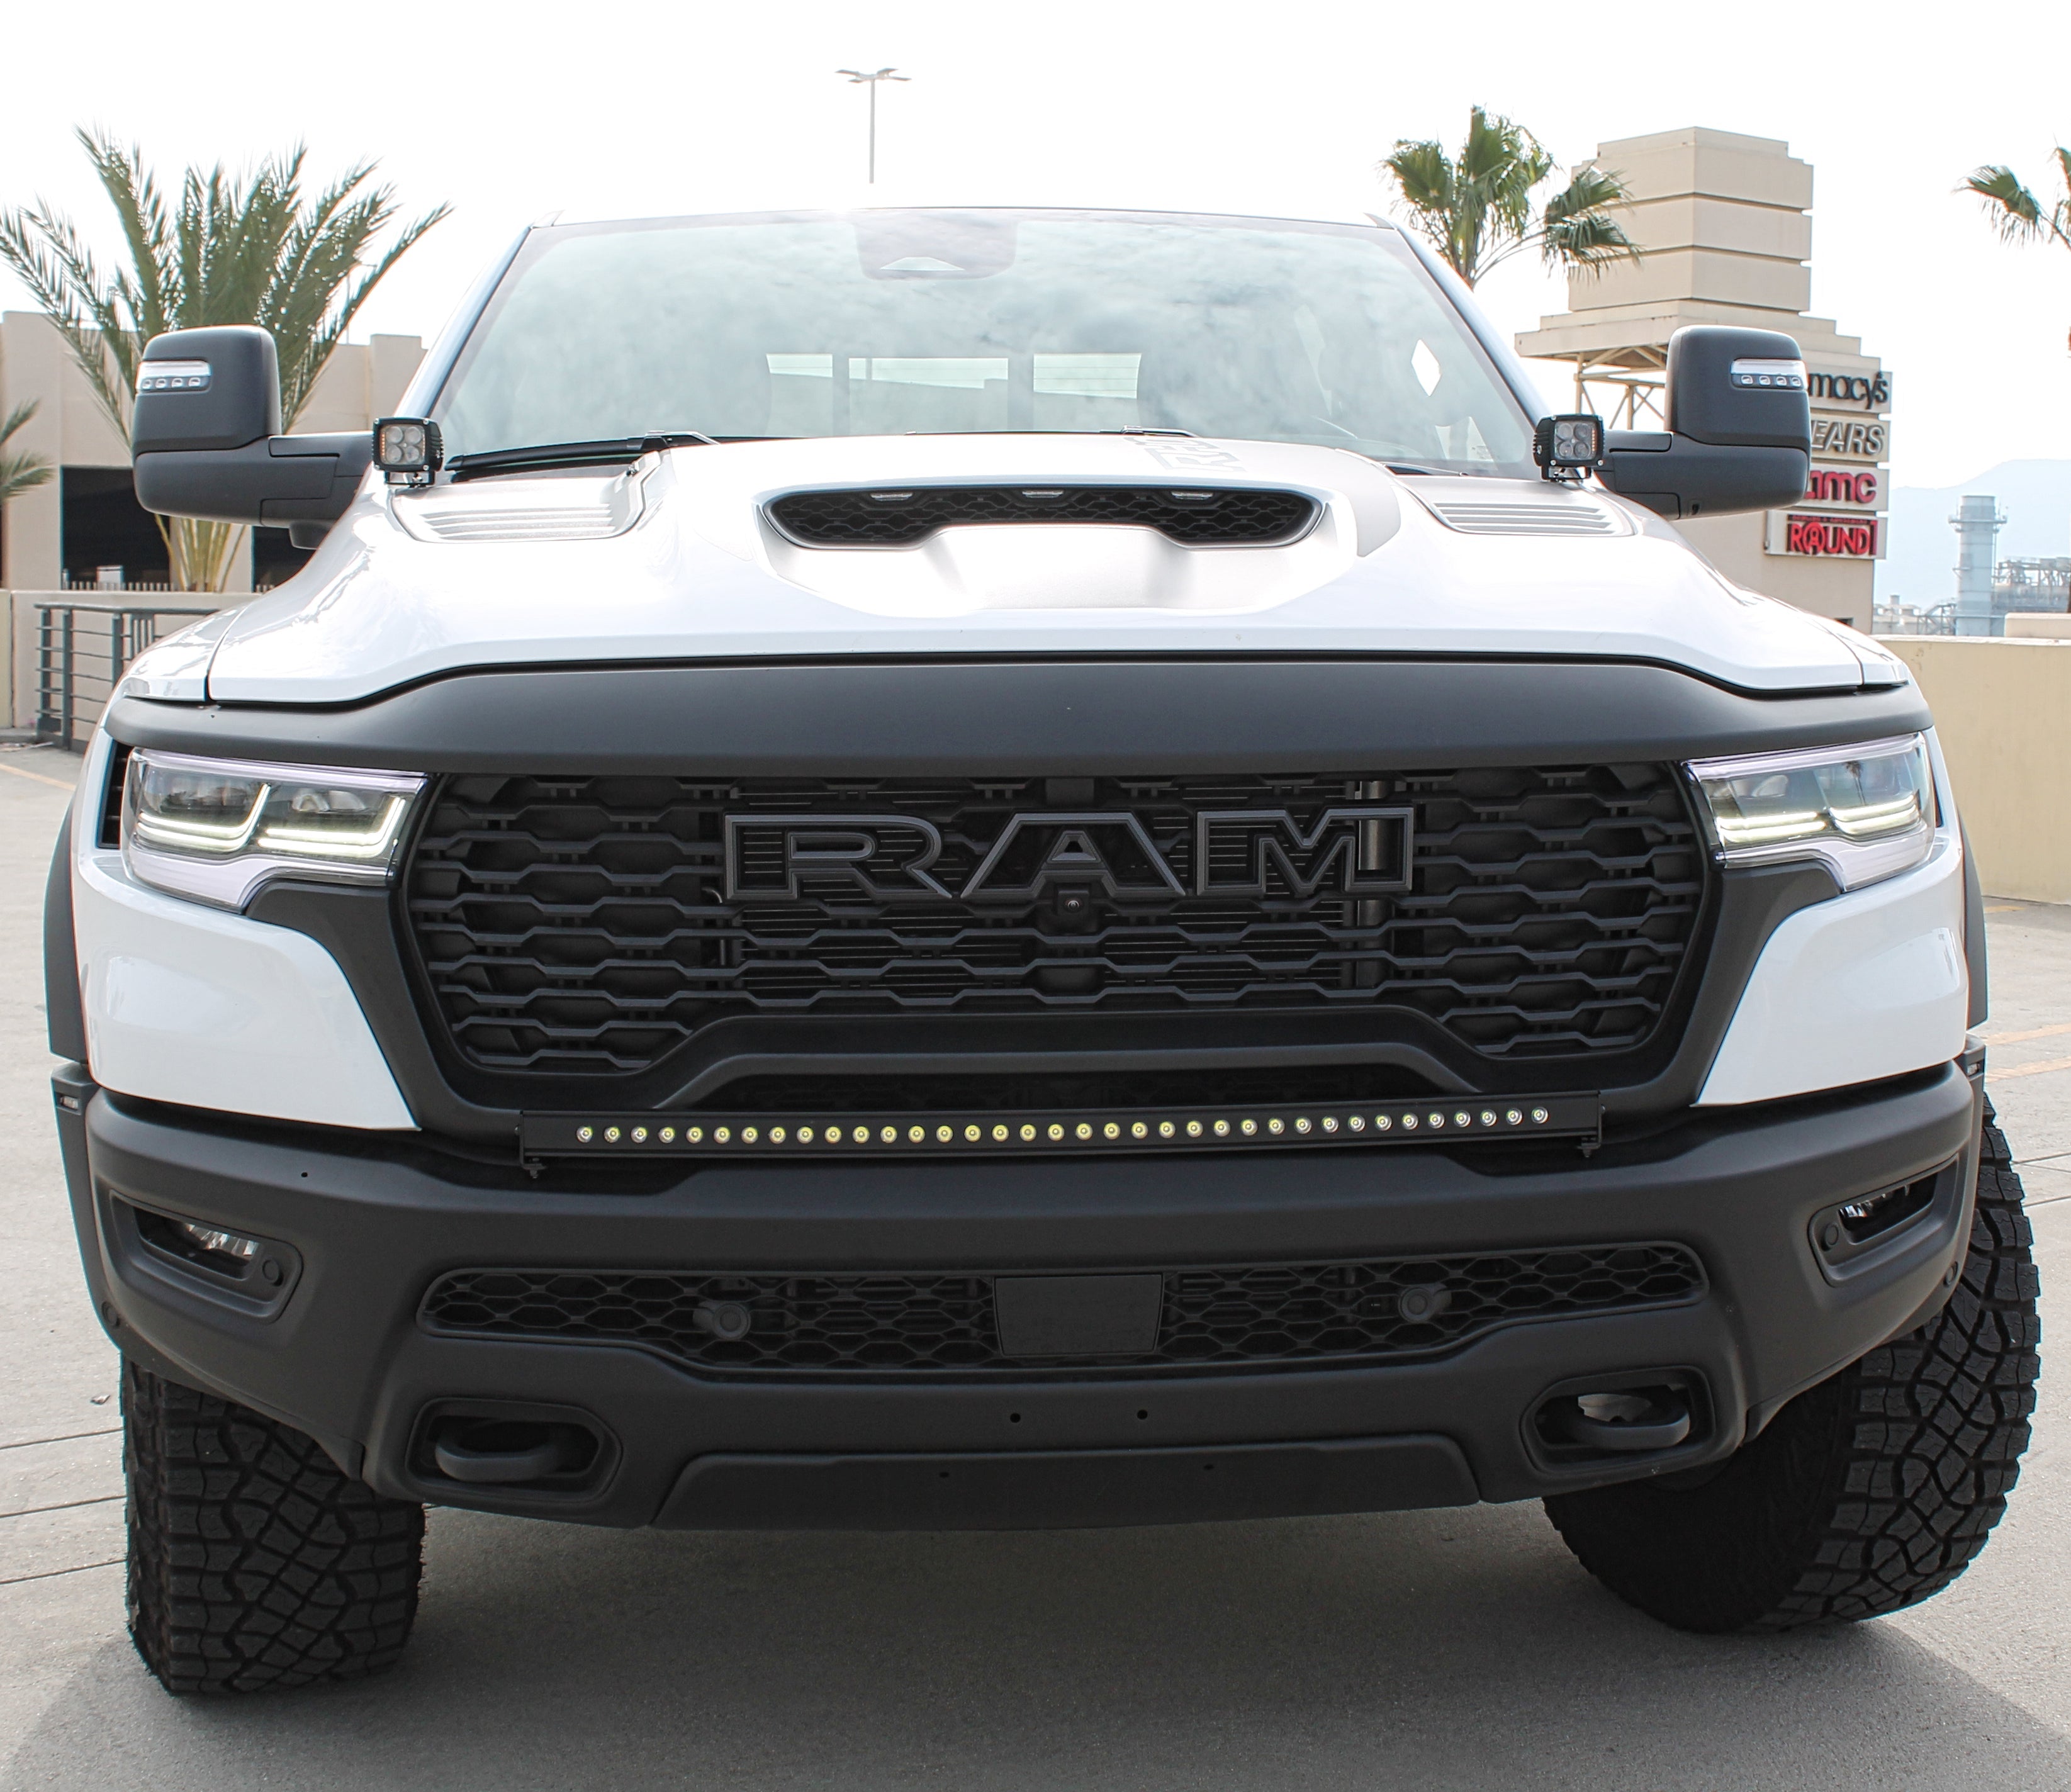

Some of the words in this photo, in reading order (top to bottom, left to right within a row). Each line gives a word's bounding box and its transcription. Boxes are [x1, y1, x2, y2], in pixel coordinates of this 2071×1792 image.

[1808, 371, 1888, 410] macy's
[1810, 420, 1885, 455] EARS
[723, 807, 1413, 900] RAM
